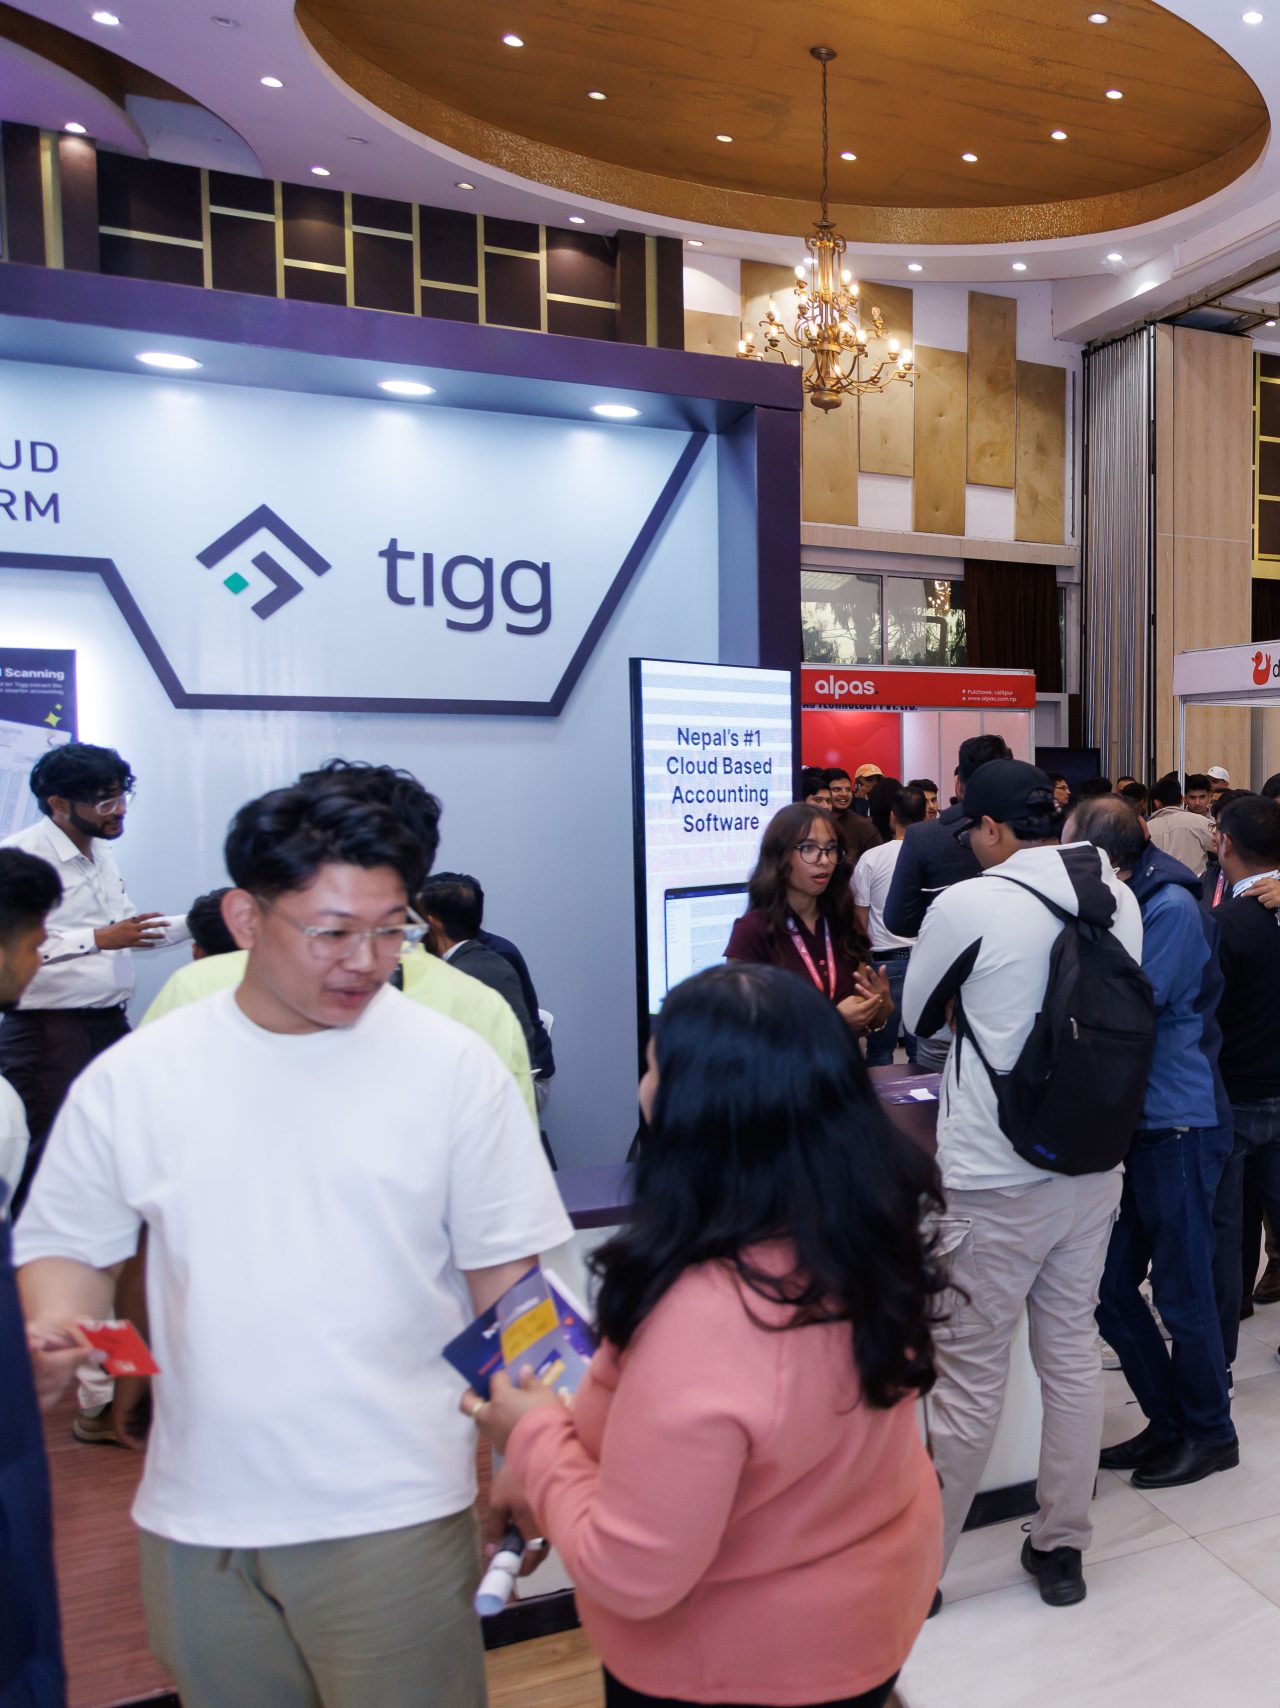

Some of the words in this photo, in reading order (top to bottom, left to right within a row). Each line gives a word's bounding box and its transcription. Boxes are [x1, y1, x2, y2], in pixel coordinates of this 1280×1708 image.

[378, 538, 552, 636] tigg
[5, 668, 65, 681] Scanning
[677, 727, 739, 751] Nepal's
[743, 729, 761, 747] #1
[666, 756, 718, 774] Cloud
[722, 756, 772, 775] Based
[671, 784, 769, 807] Accounting
[683, 813, 759, 833] Software
